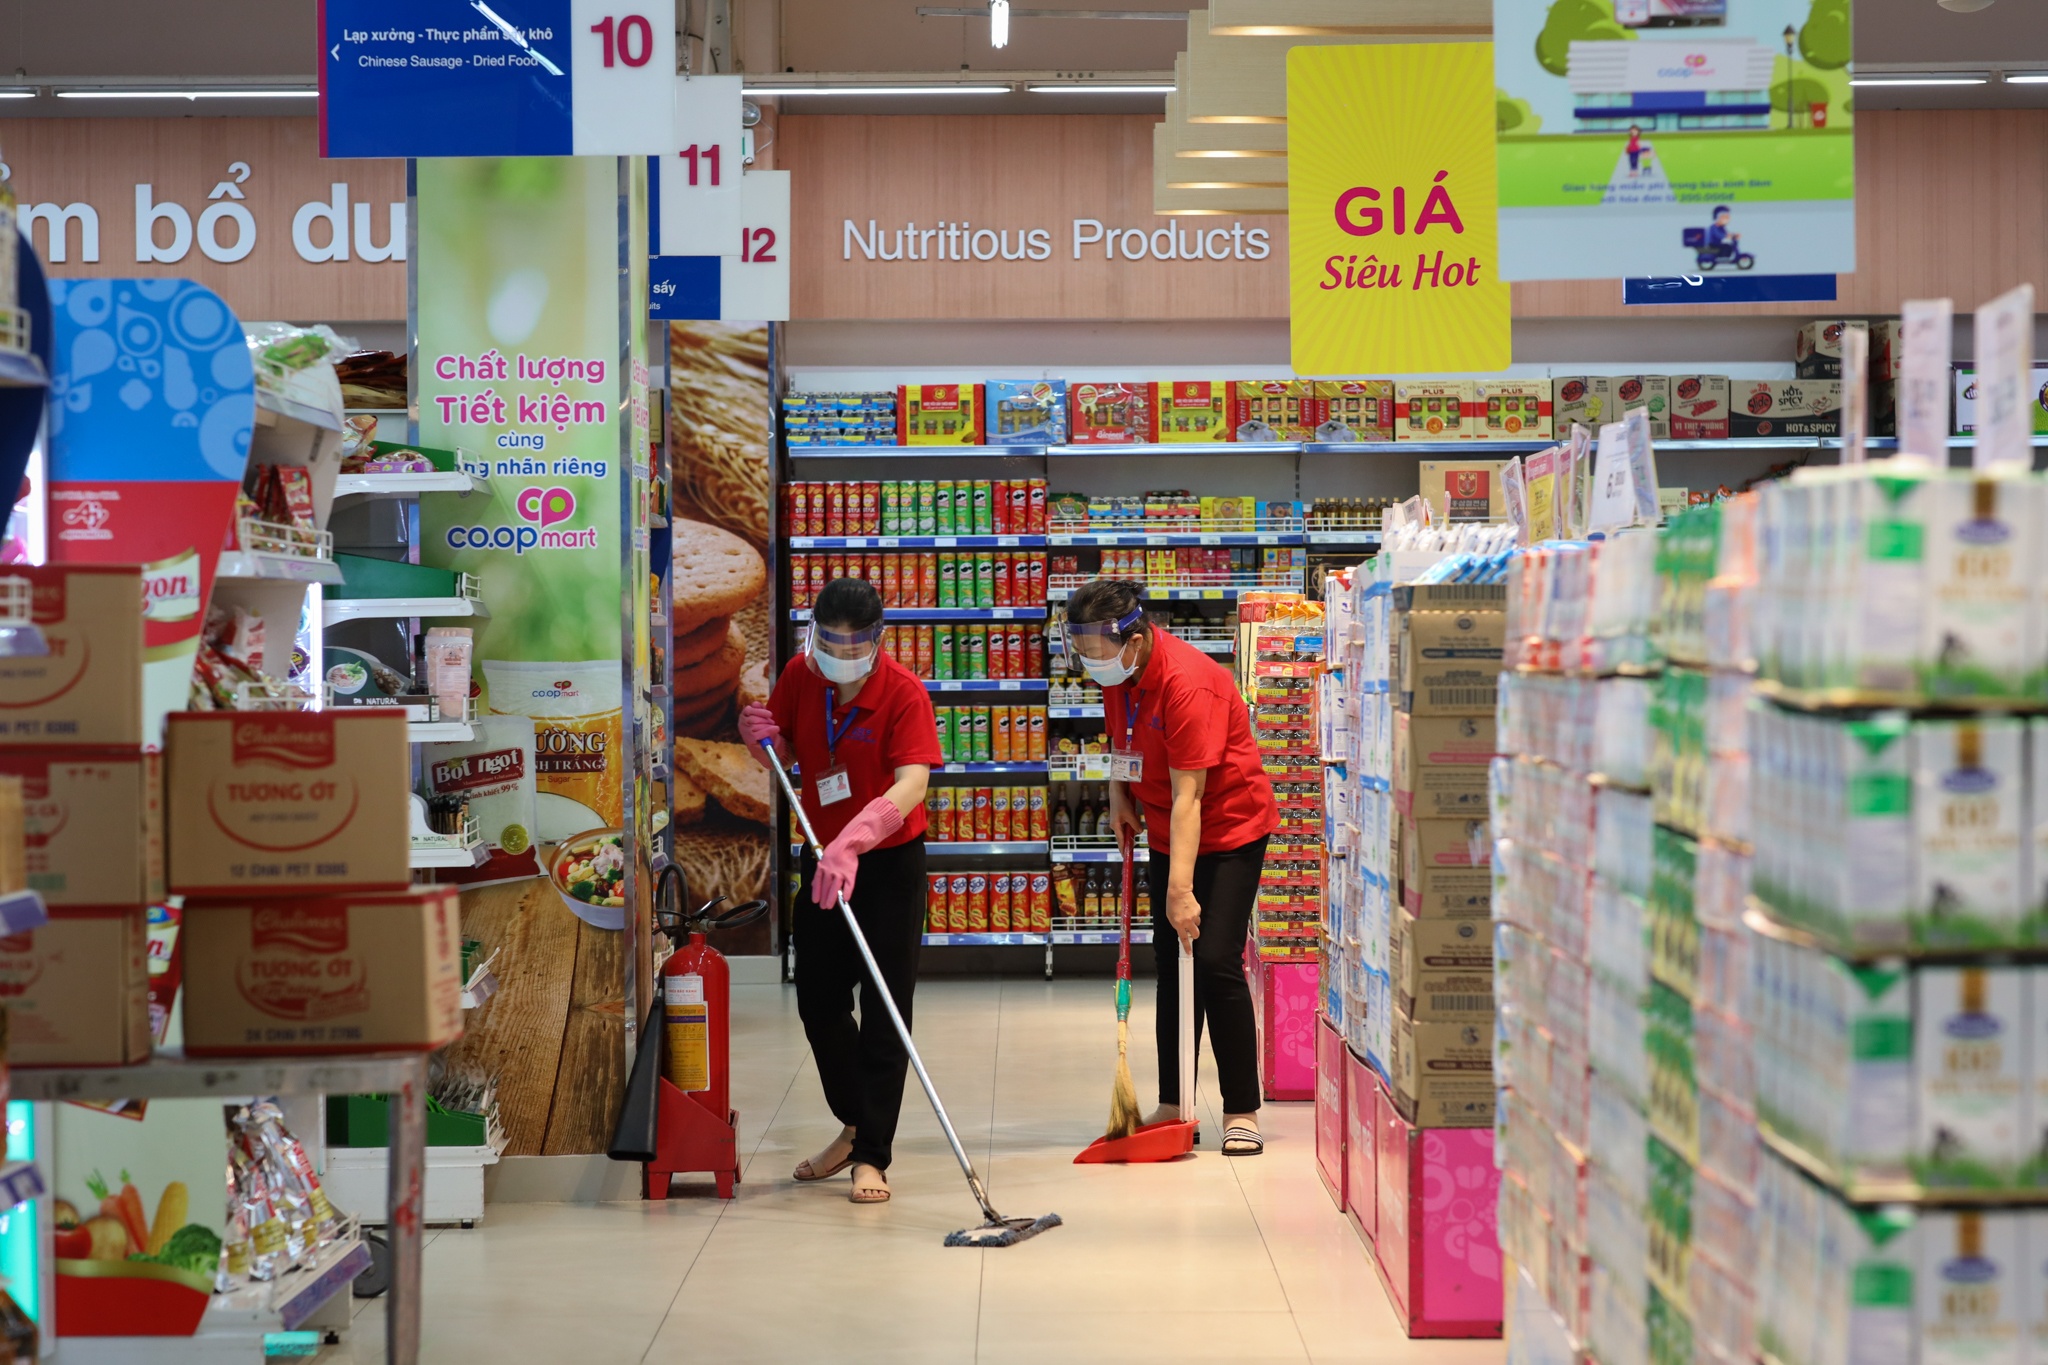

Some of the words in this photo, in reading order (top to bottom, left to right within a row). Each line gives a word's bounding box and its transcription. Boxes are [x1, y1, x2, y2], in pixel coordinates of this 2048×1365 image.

[344, 28, 370, 44] Lạp
[371, 28, 415, 43] xưởng
[425, 28, 460, 44] Thực
[463, 27, 499, 43] phẩm
[528, 28, 553, 41] khô
[591, 15, 654, 68] 10
[358, 55, 408, 68] Chinese
[410, 55, 462, 69] Sausage
[473, 55, 505, 67] Dried
[508, 55, 539, 67] Food
[679, 144, 720, 186] 11
[135, 162, 257, 263] bổ
[1334, 170, 1465, 237] GIÁ
[843, 220, 1051, 260] Nutritious
[1073, 219, 1271, 260] Products
[1319, 254, 1403, 290] Siêu
[1412, 250, 1482, 290] Hot
[653, 280, 676, 296] sấy
[435, 350, 507, 379] Chất
[518, 355, 605, 385] lượng
[435, 389, 506, 424] Tiết
[519, 394, 605, 431] kiệm
[497, 432, 544, 450] cùng
[496, 458, 546, 475] nhãn
[553, 458, 607, 479] riêng
[366, 697, 400, 705] NATURAL
[478, 750, 519, 775] ngọt
[547, 776, 571, 784] Sugar
